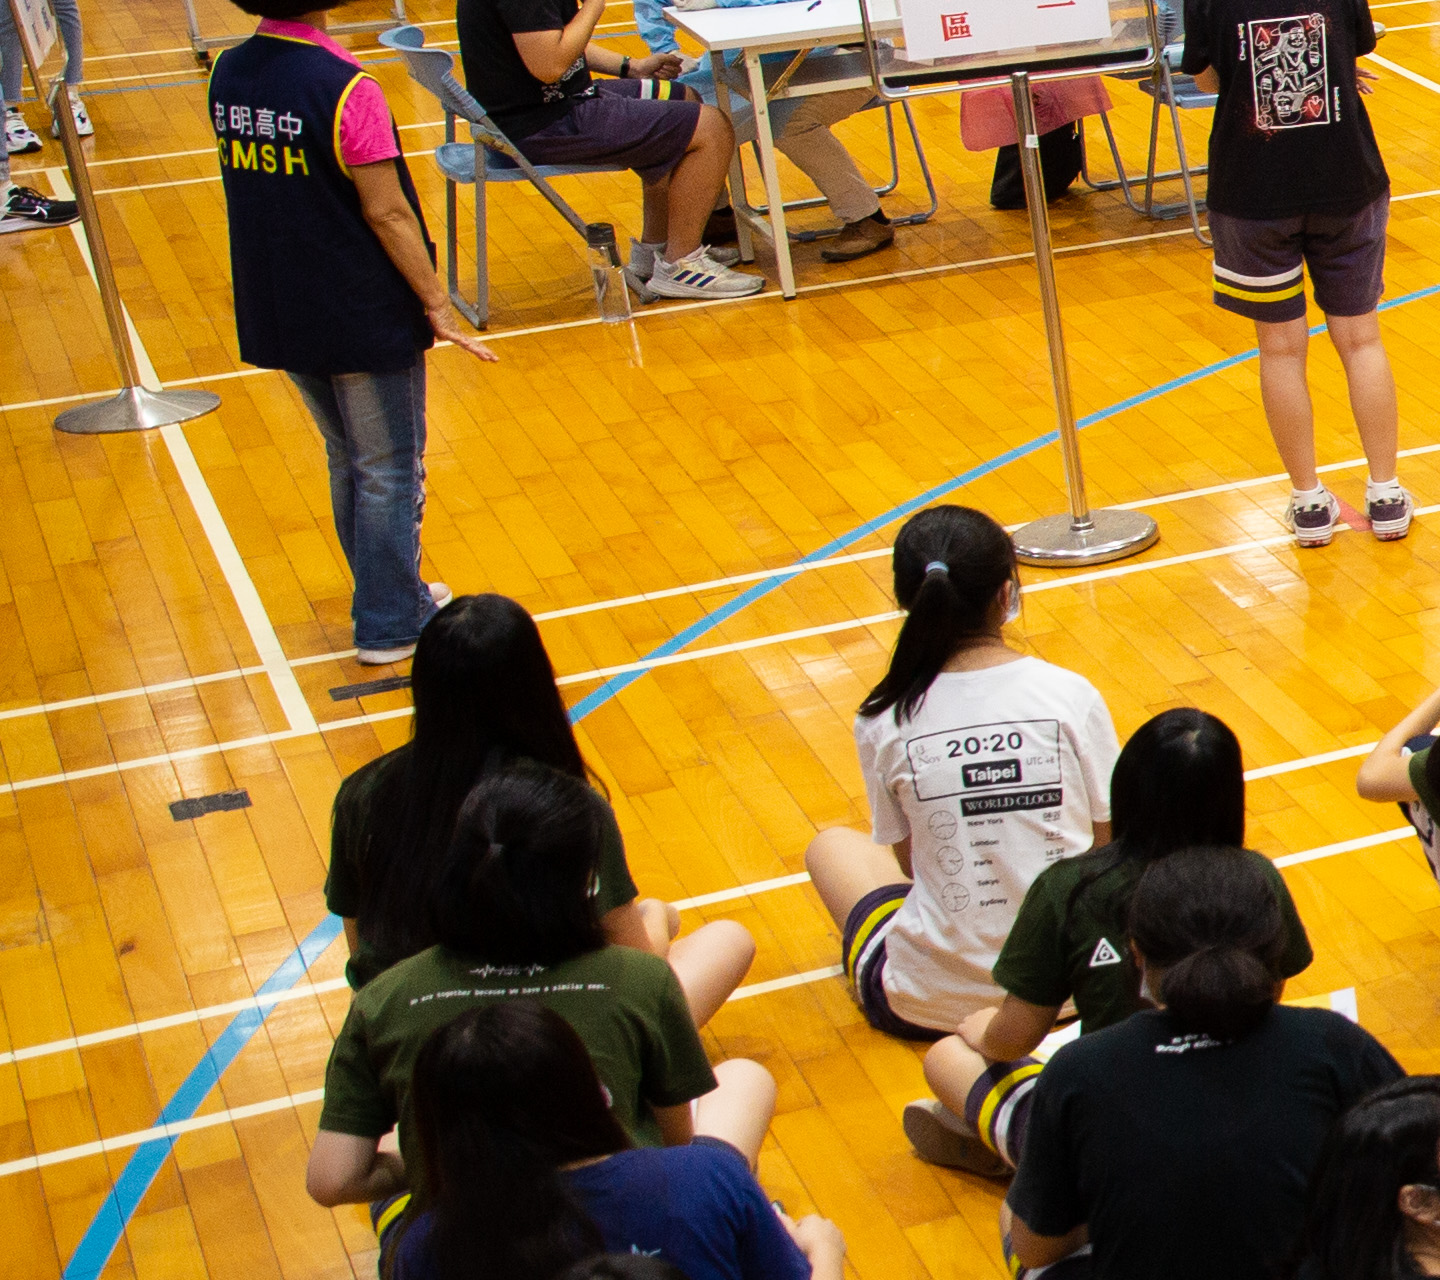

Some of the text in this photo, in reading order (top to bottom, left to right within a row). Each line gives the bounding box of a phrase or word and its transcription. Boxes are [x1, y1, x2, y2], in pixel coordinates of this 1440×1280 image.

[218, 138, 310, 177] CMSH
[946, 731, 1023, 758] 20:20
[1026, 756, 1043, 766] UTC
[967, 764, 1017, 783] Taipei
[965, 791, 1061, 812] WORLD CLOCKS
[979, 897, 1008, 907] Sydney
